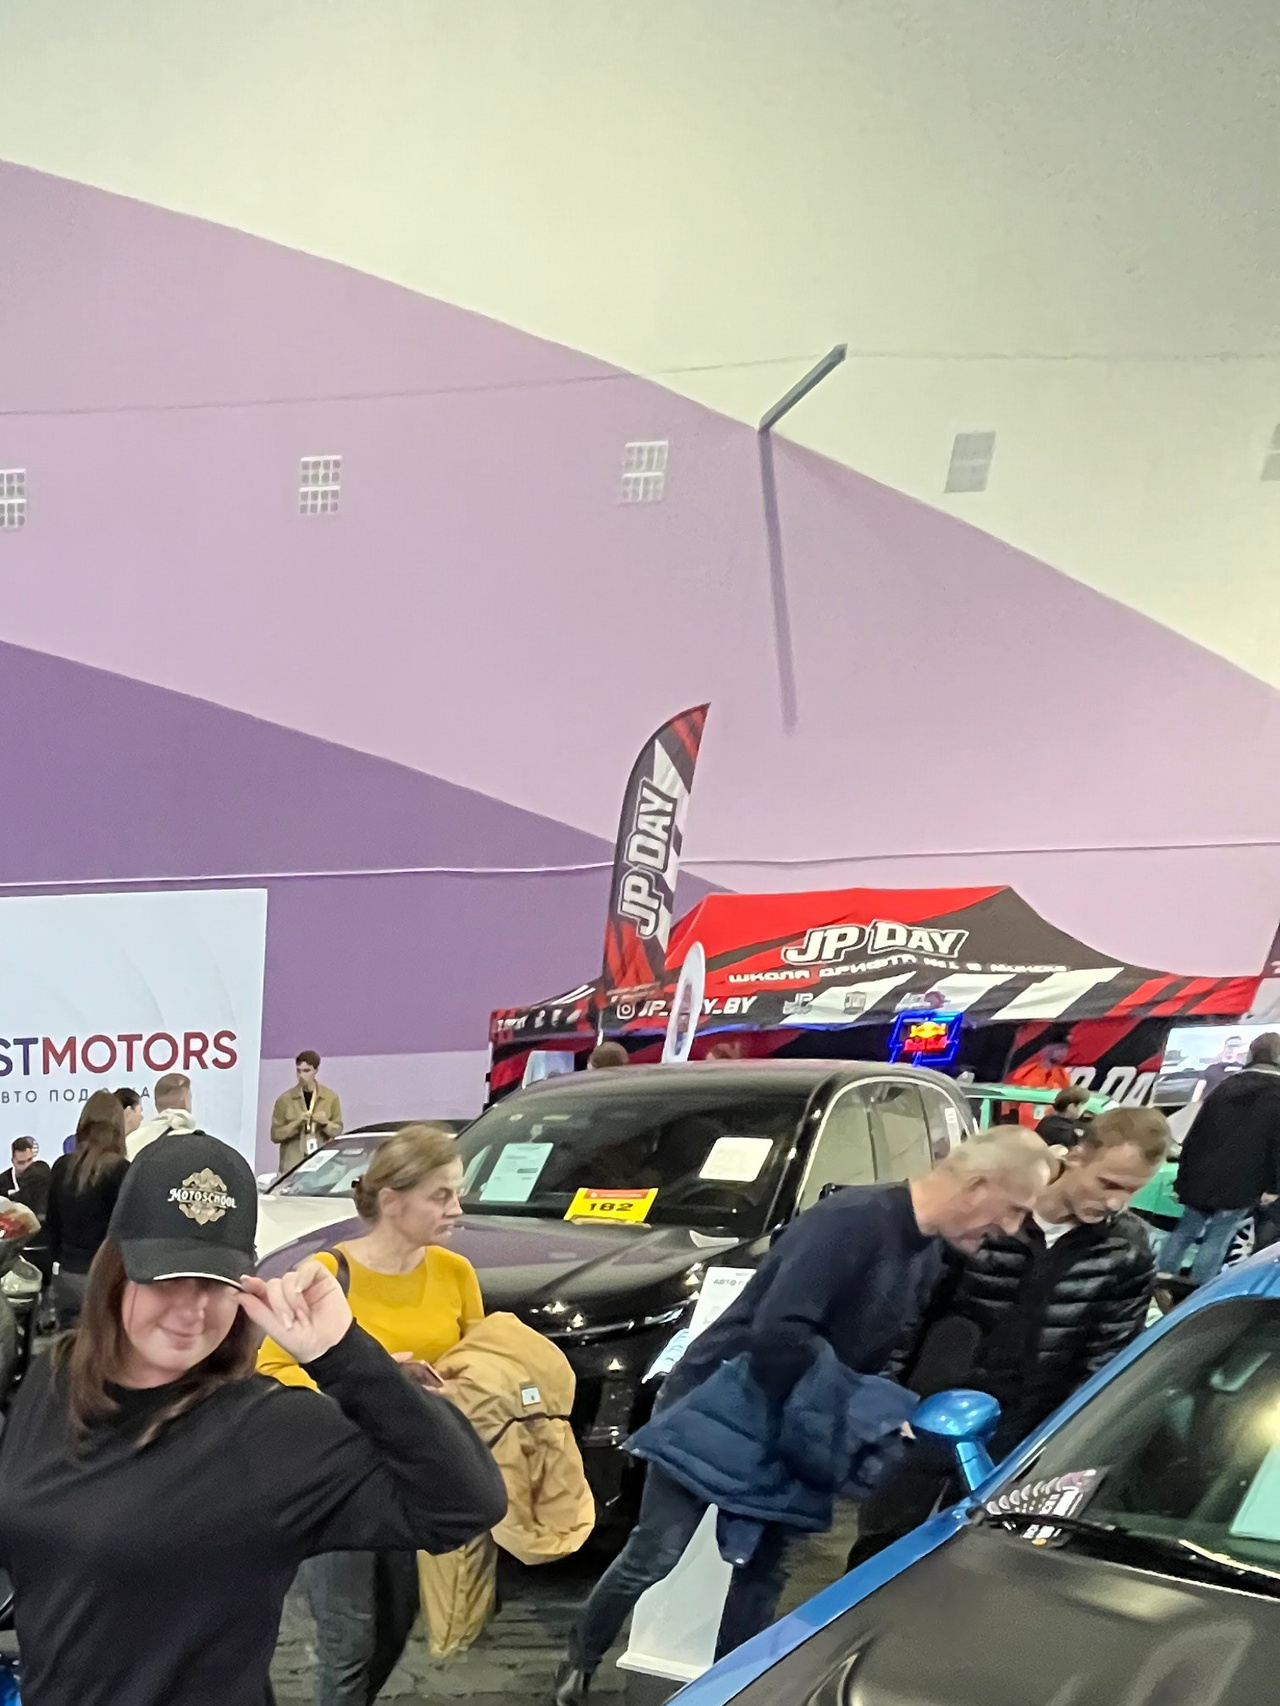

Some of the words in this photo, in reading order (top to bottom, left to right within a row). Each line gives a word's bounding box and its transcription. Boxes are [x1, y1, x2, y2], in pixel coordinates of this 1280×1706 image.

[625, 779, 676, 872] DAY
[619, 869, 663, 938] JP
[783, 925, 863, 963] JP
[870, 920, 966, 956] DAY
[49, 1087, 90, 1103] ПОД
